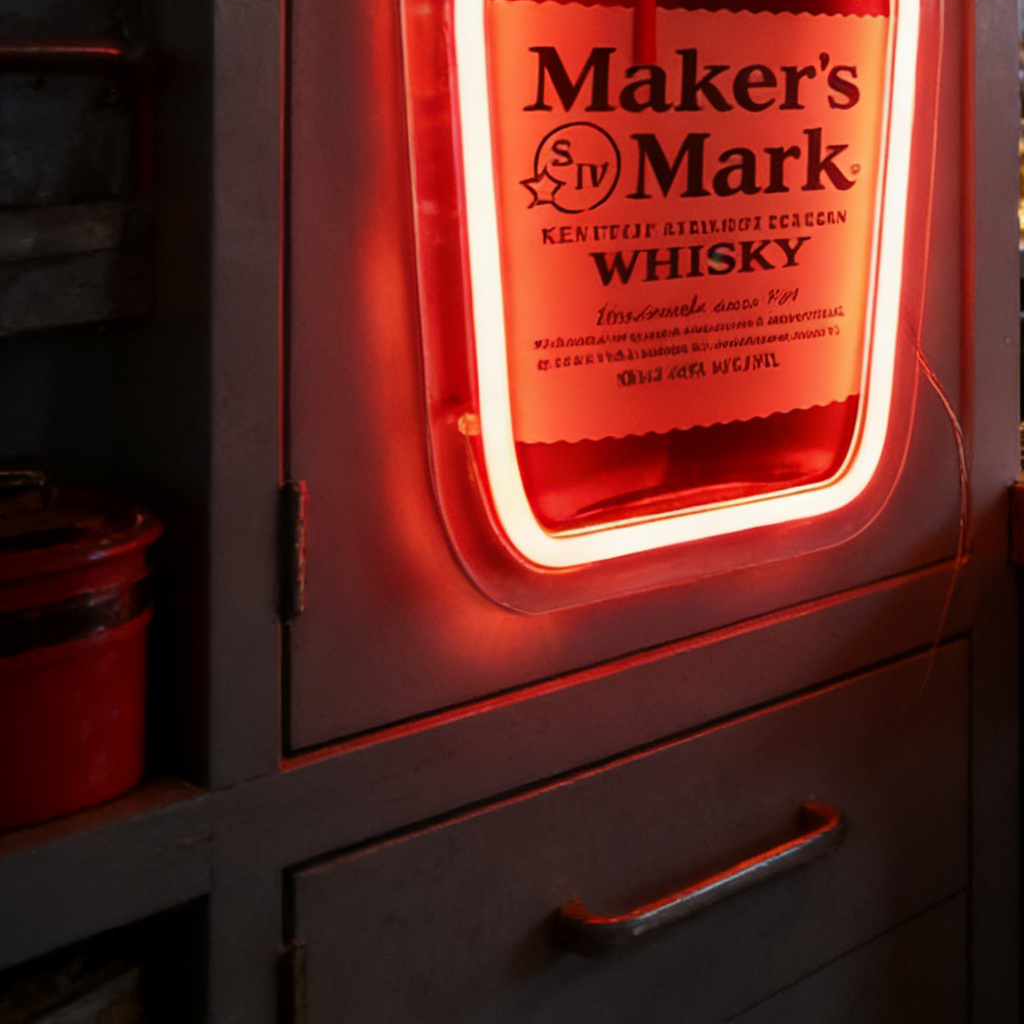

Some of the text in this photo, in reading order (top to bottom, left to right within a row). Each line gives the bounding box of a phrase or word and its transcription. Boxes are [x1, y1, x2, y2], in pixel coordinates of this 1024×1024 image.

[523, 46, 860, 113] Maker's
[551, 139, 573, 167] S
[626, 127, 856, 200] Mark
[589, 236, 811, 286] WHISKY
